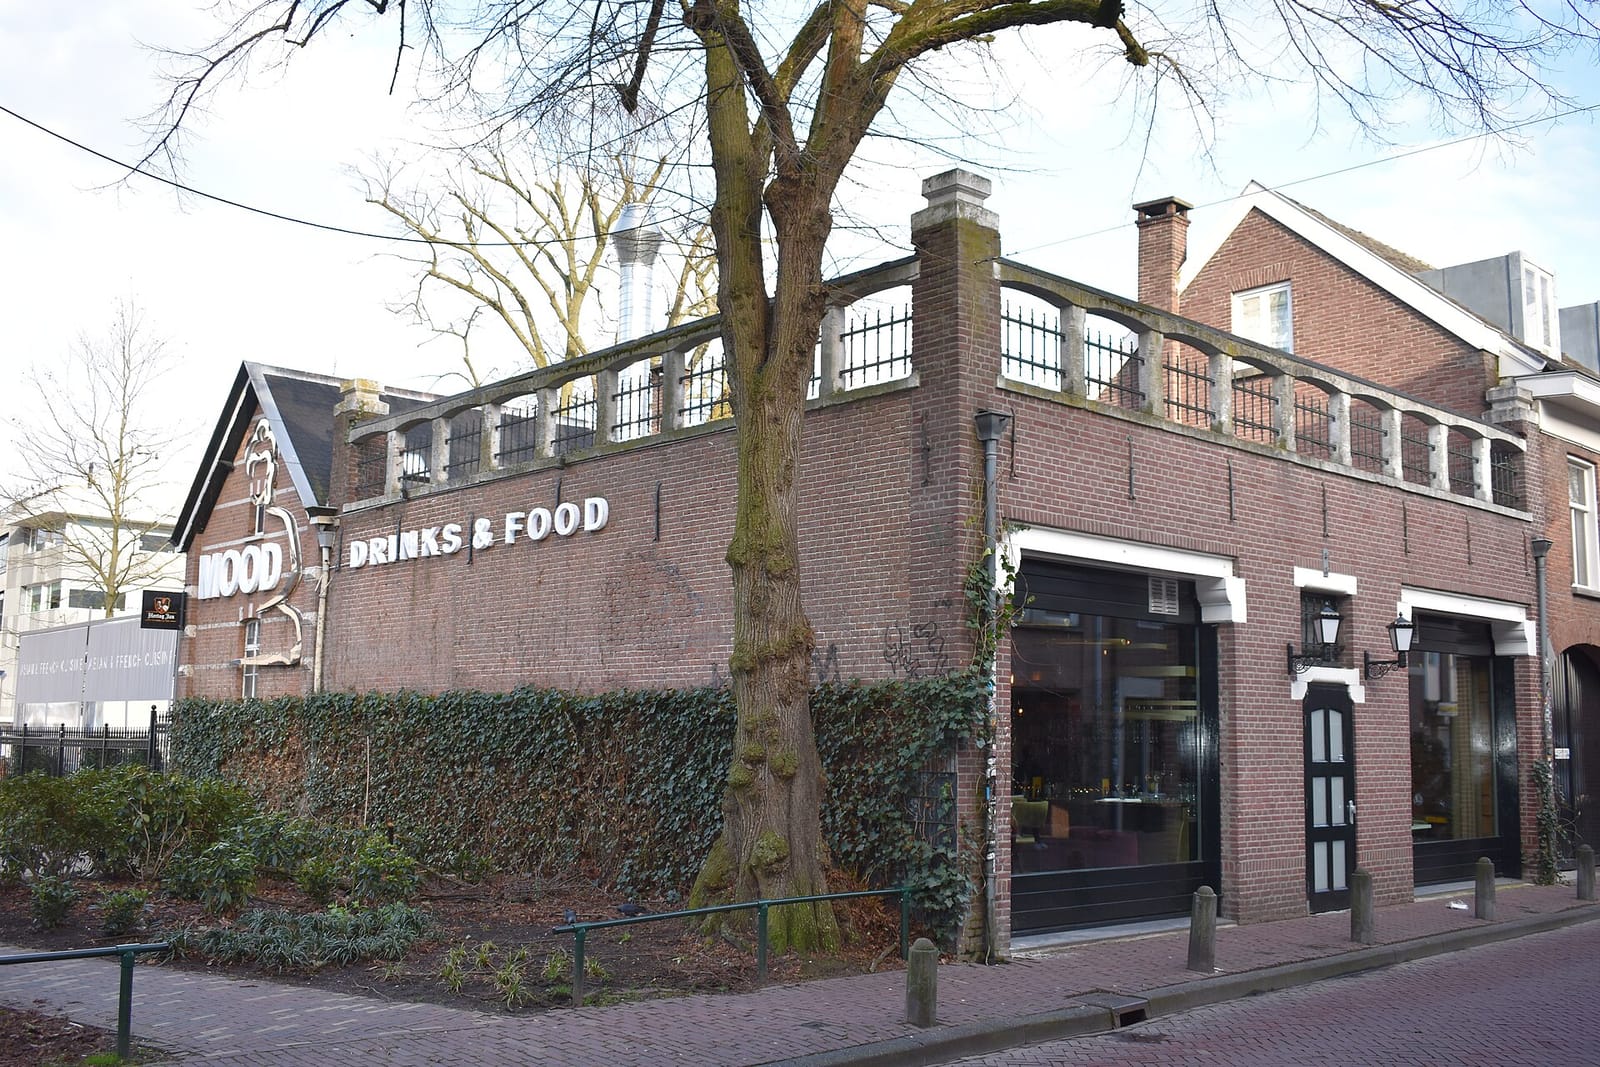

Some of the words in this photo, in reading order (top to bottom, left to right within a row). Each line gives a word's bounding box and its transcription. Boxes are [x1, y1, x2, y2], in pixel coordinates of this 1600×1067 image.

[349, 523, 462, 568] DRINKS
[472, 518, 494, 550] &
[505, 497, 609, 544] FOOD
[198, 542, 283, 600] MOOD
